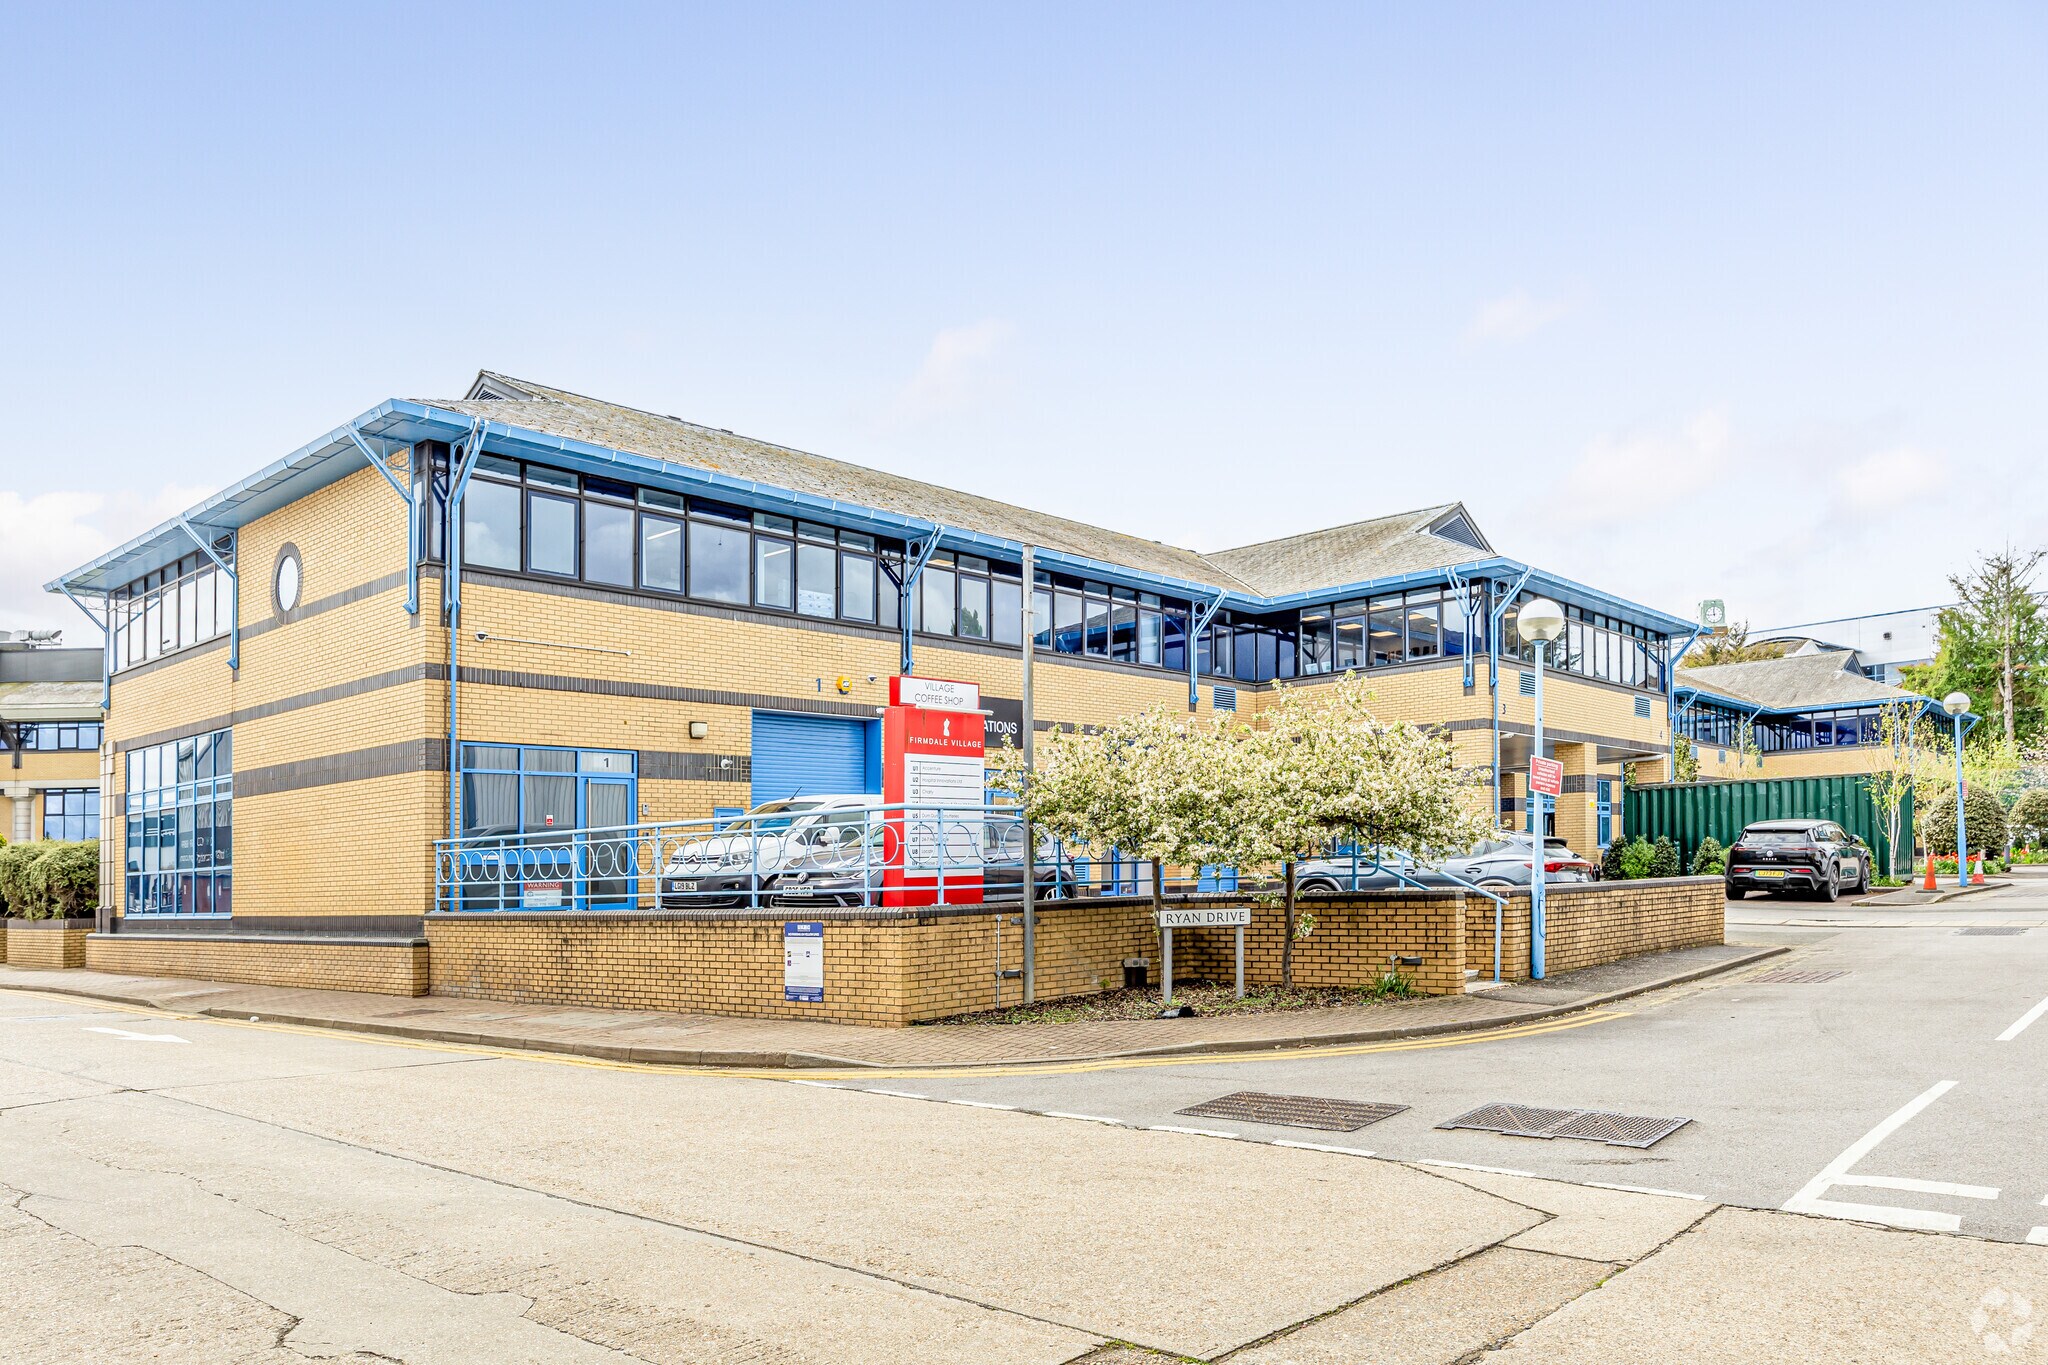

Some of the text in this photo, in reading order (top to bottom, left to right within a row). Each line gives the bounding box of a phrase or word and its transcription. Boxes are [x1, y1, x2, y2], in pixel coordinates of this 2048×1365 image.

[815, 678, 821, 692] 1
[925, 682, 955, 693] VILLAGE
[914, 693, 964, 706] COFFEE SHOP
[1502, 703, 1507, 715] 3
[909, 736, 982, 749] FIRMDALE VILLAGE
[603, 757, 609, 768] 1
[1166, 911, 1245, 924] RYAN DRIVE
